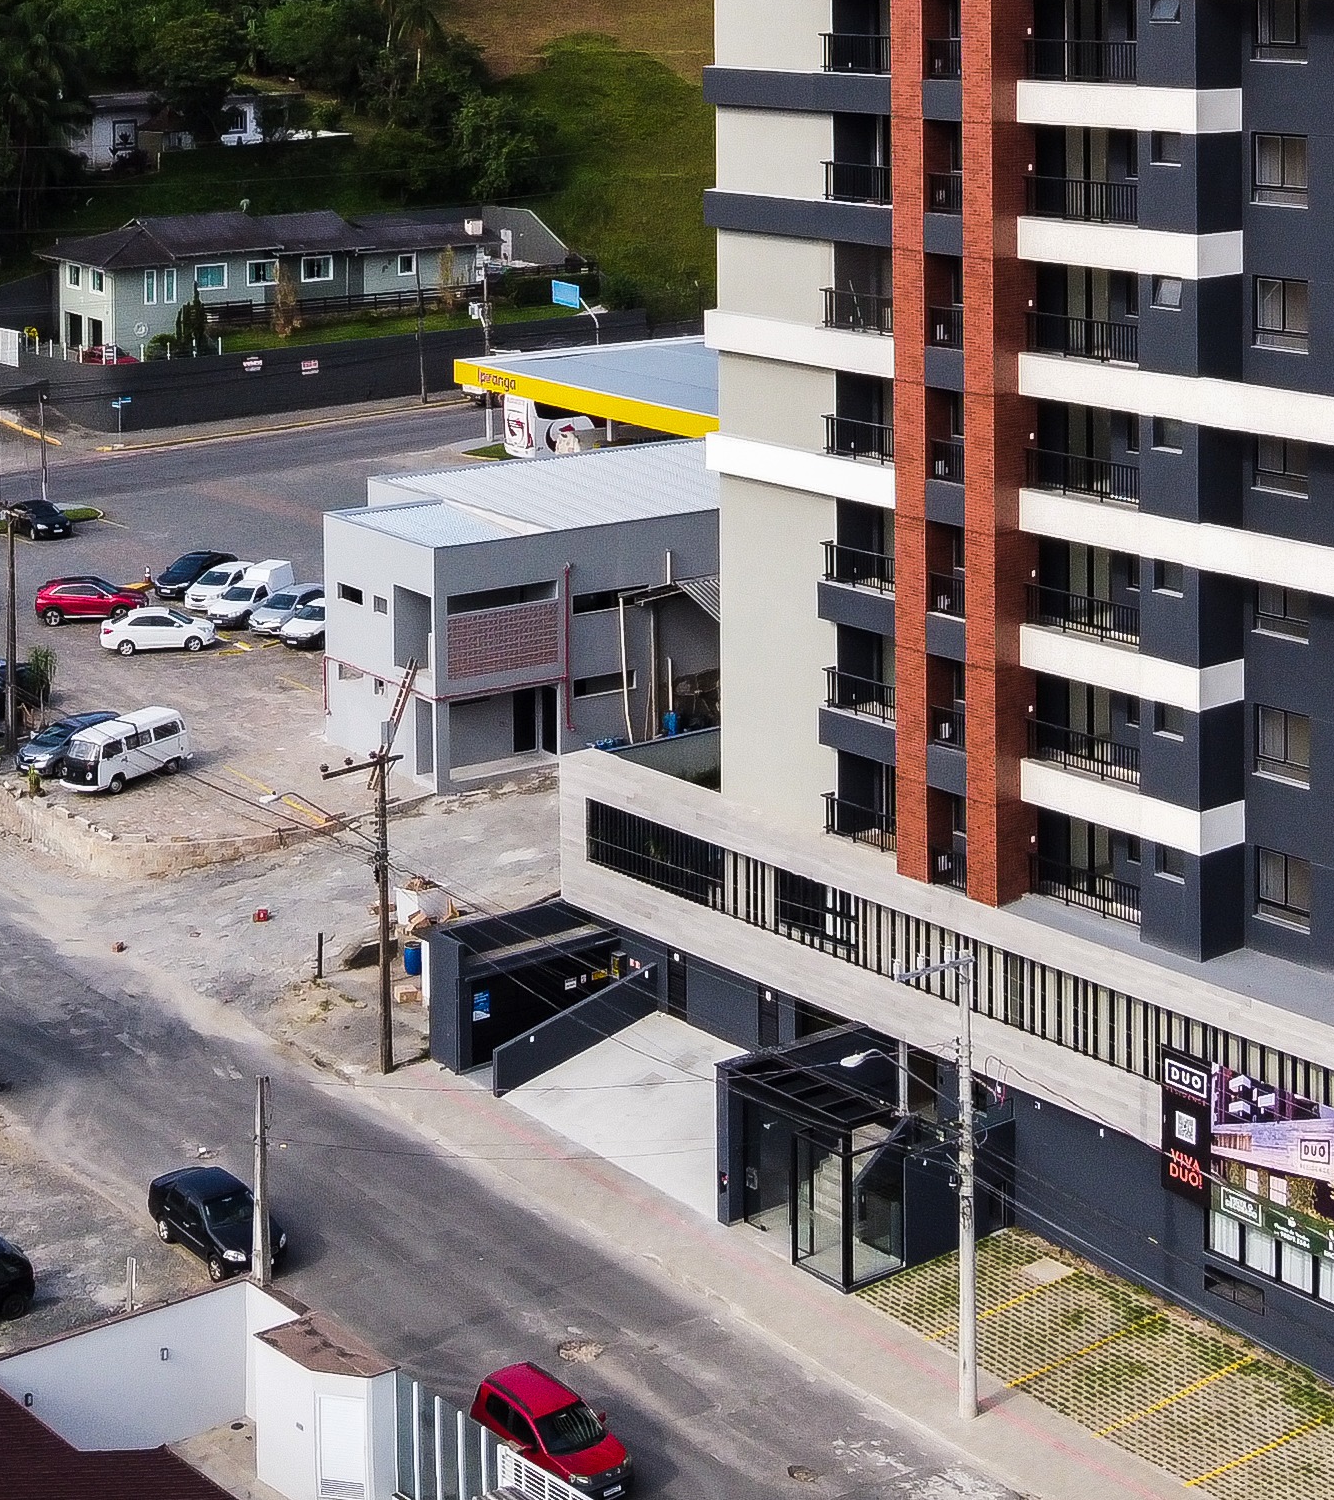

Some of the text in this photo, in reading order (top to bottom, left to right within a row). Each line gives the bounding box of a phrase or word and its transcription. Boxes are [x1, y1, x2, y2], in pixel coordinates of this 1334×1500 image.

[1171, 1066, 1202, 1090] DUO
[1170, 1148, 1201, 1174] VIVA
[1304, 1145, 1325, 1157] DUO
[1169, 1162, 1203, 1189] DUO!
